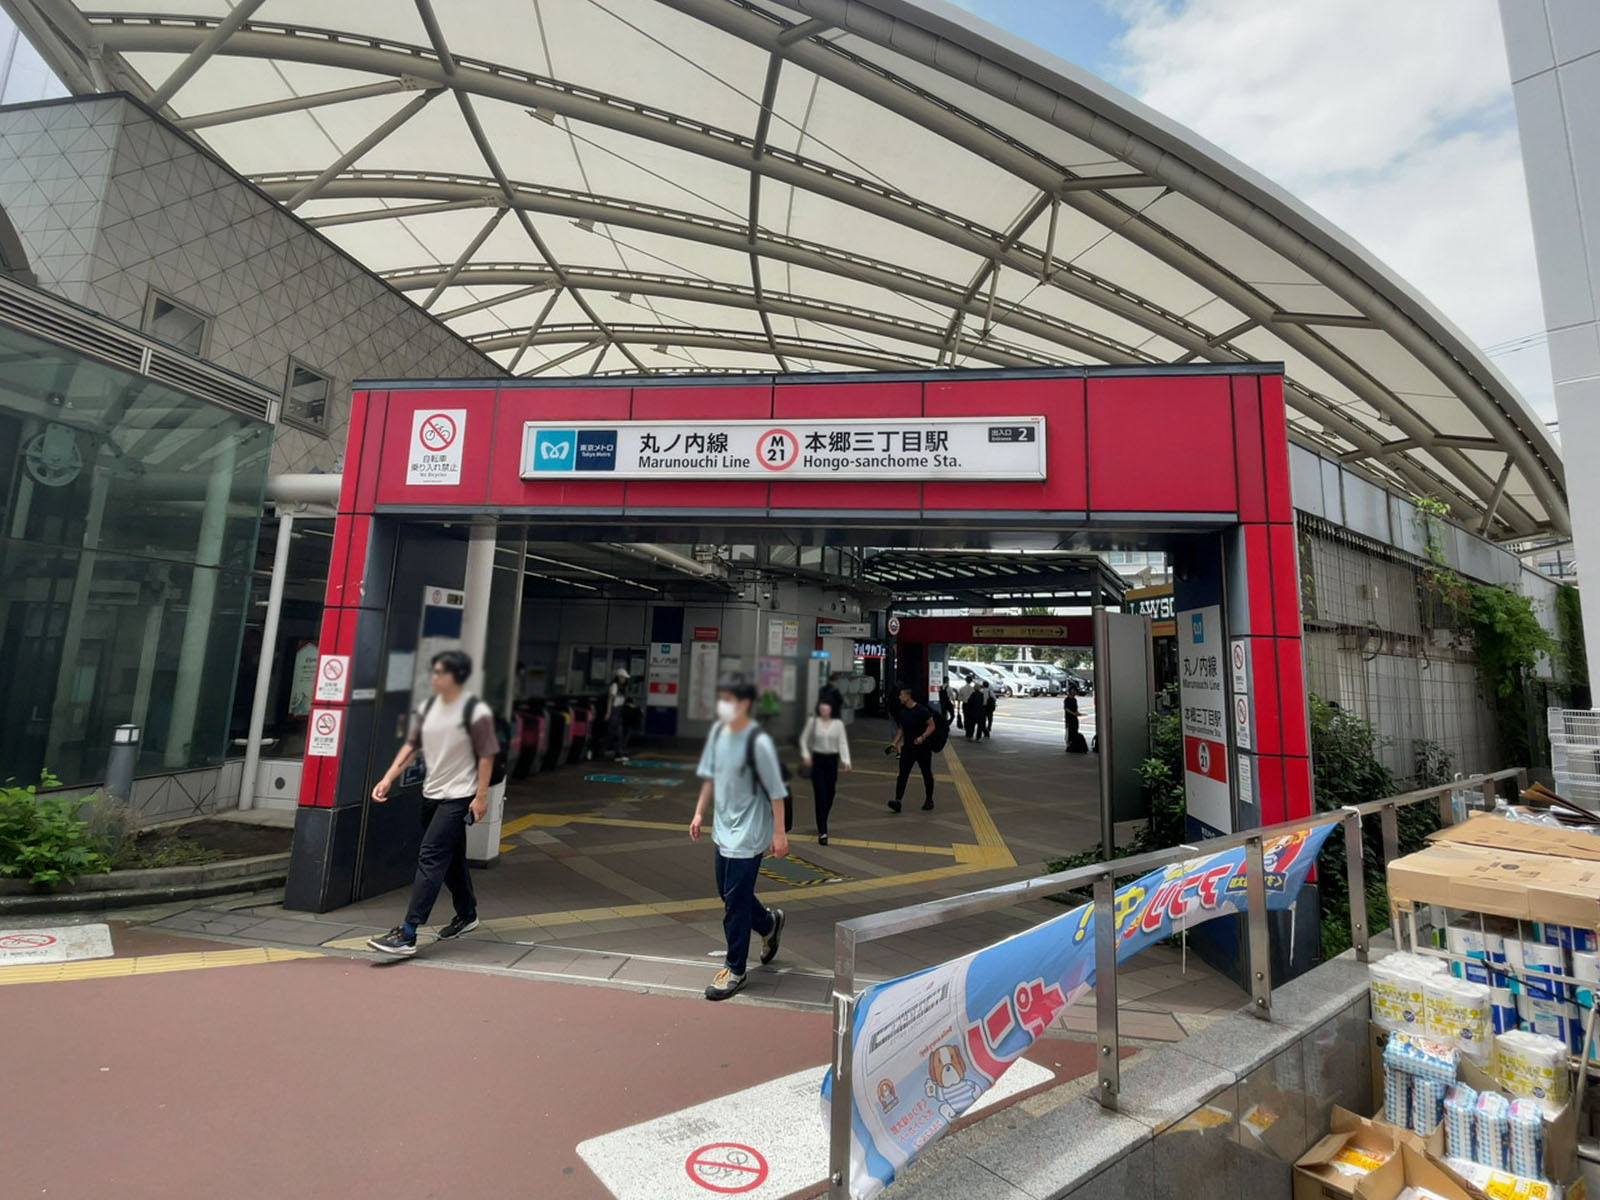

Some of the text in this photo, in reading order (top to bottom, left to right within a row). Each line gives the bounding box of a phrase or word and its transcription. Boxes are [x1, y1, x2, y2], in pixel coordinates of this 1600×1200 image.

[1018, 428, 1028, 441] 2
[580, 444, 614, 452] 東京メトロ
[639, 433, 729, 454] 丸ノ内線
[770, 436, 785, 448] M
[804, 431, 949, 453] 本郷三丁目駅
[422, 455, 448, 463] 自転車
[638, 455, 751, 469] Marunouchi Line
[767, 449, 786, 462] 21
[411, 463, 458, 472] 乗り入れ禁止
[803, 454, 962, 471] Hongo-sanchome Sta.
[1183, 656, 1218, 678] 丸ノ内線
[1184, 707, 1222, 727] 本郷三丁目駅
[1200, 755, 1208, 768] 21
